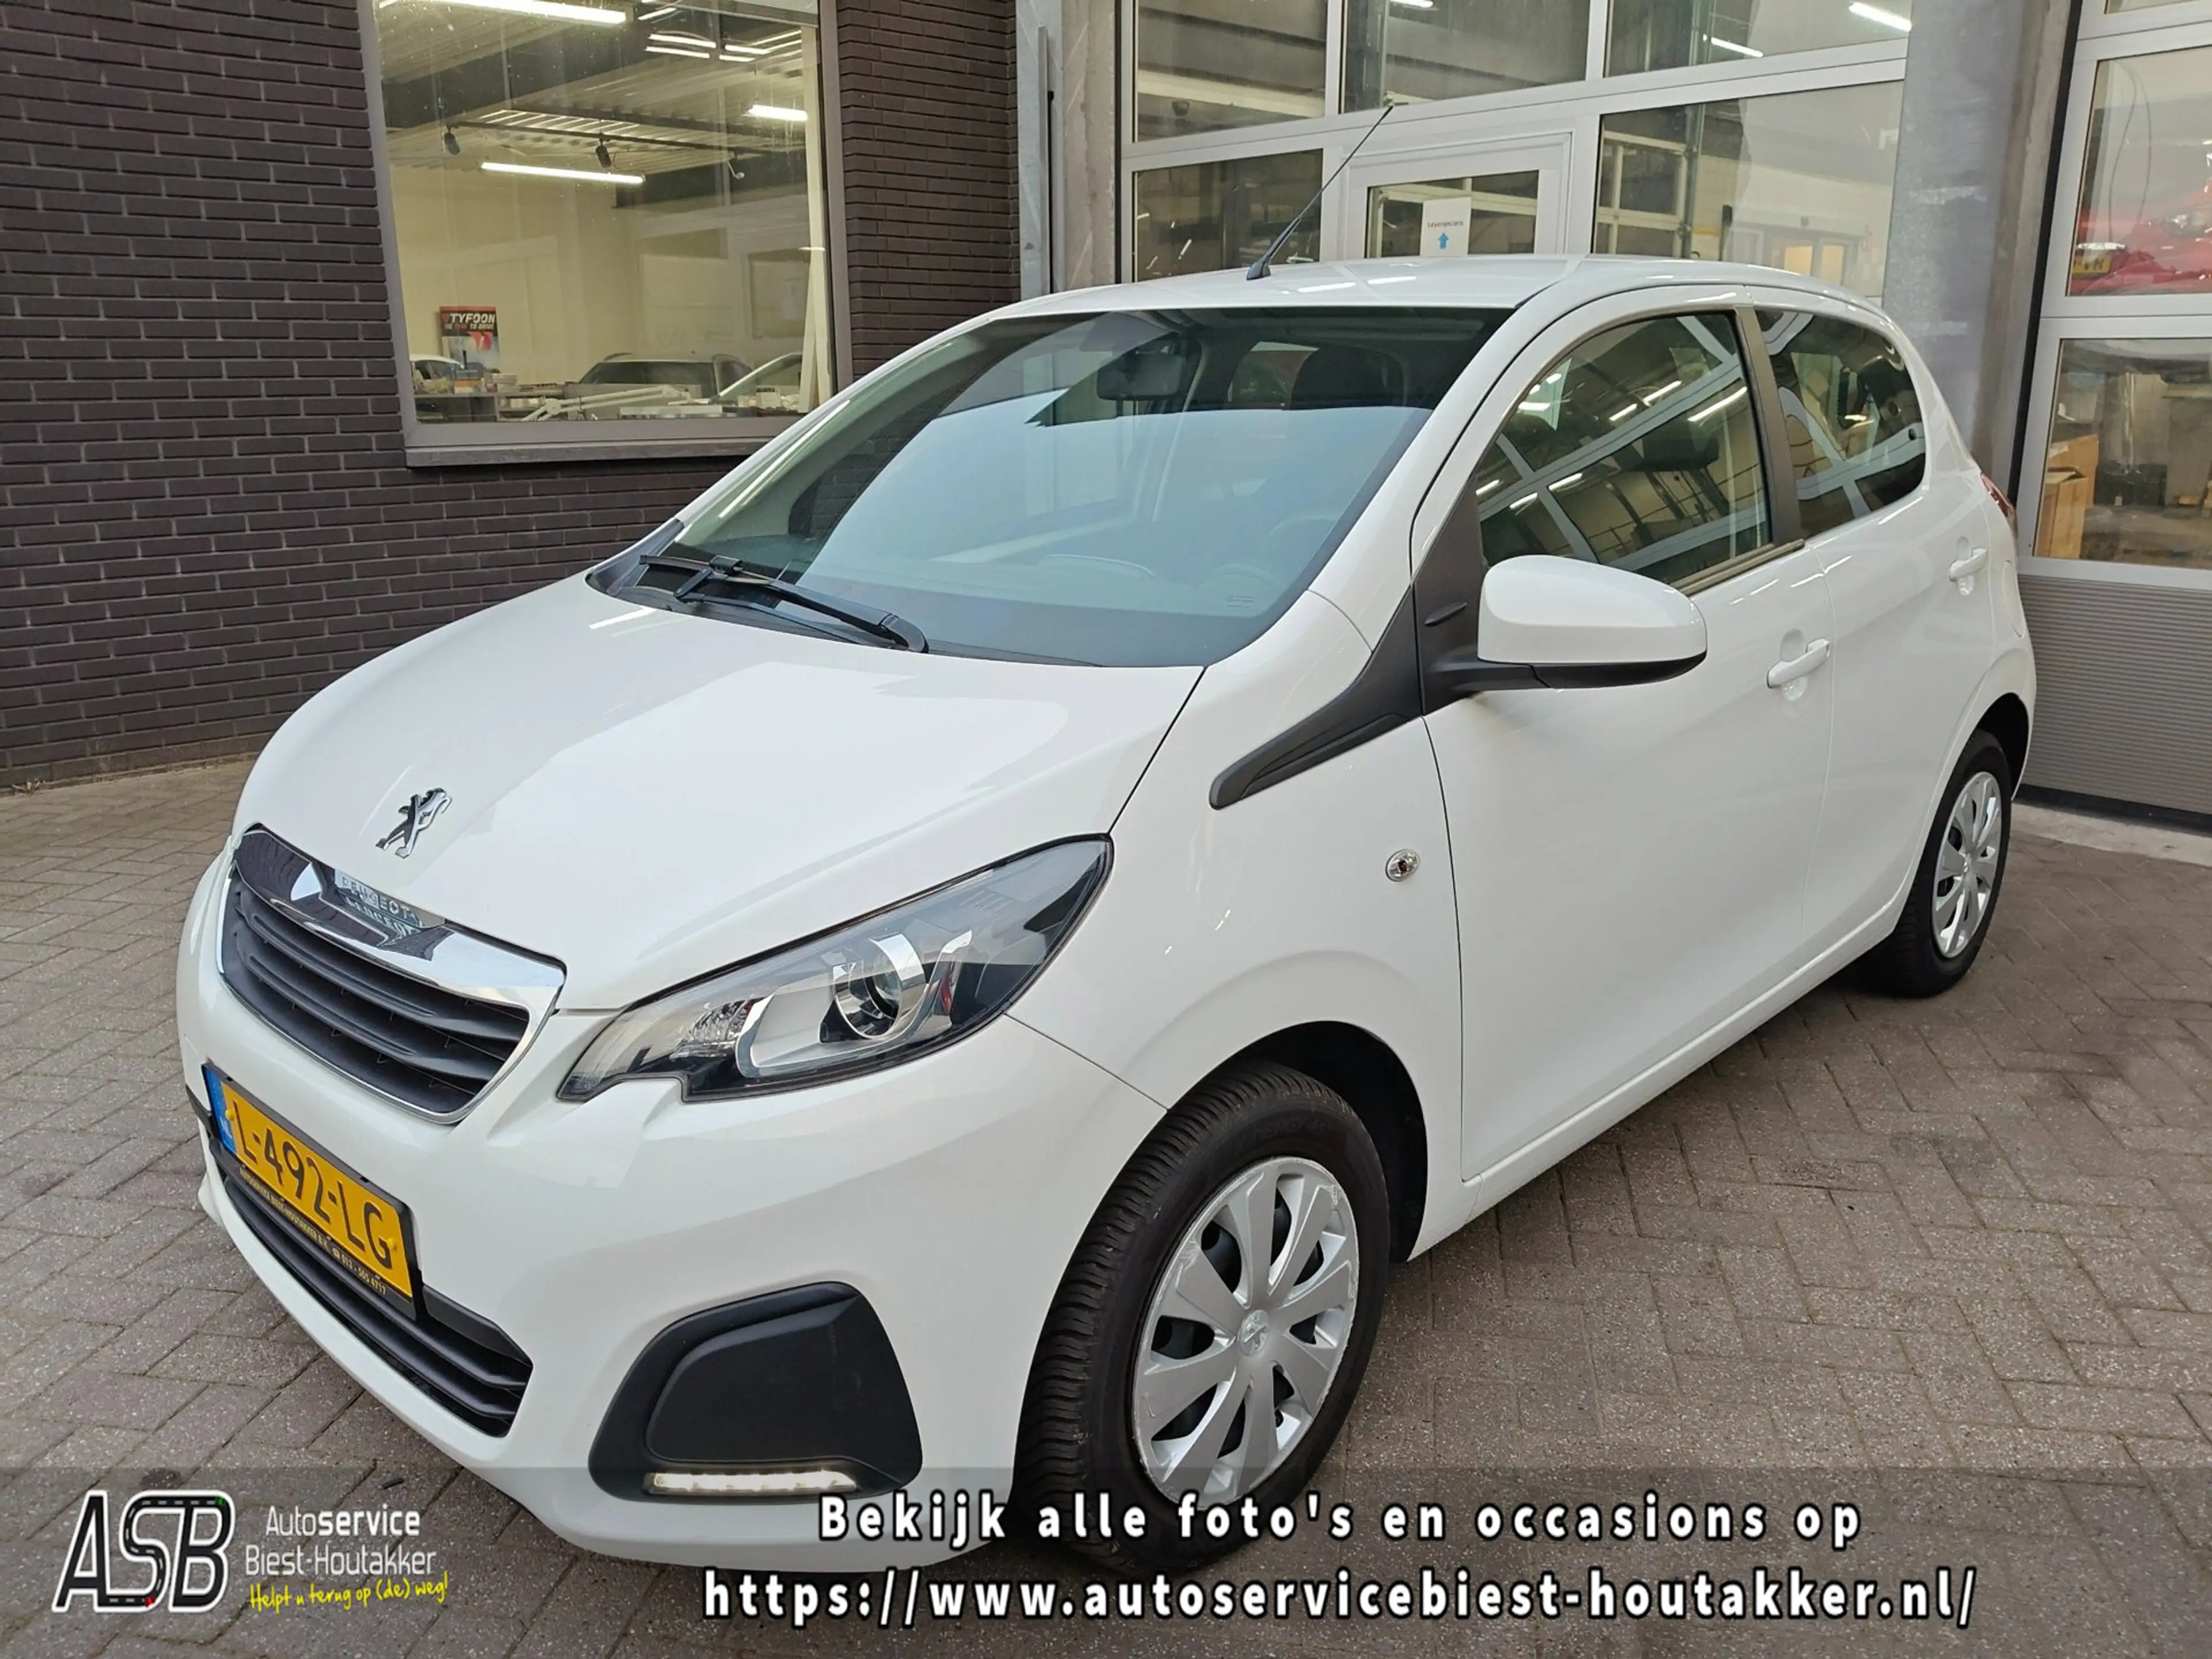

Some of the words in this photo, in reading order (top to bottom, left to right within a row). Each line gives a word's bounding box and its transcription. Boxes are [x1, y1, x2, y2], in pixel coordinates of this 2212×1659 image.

[450, 313, 495, 323] TYFOON
[342, 876, 411, 920] PEUGEOT
[232, 1098, 393, 1270] L-492-LG
